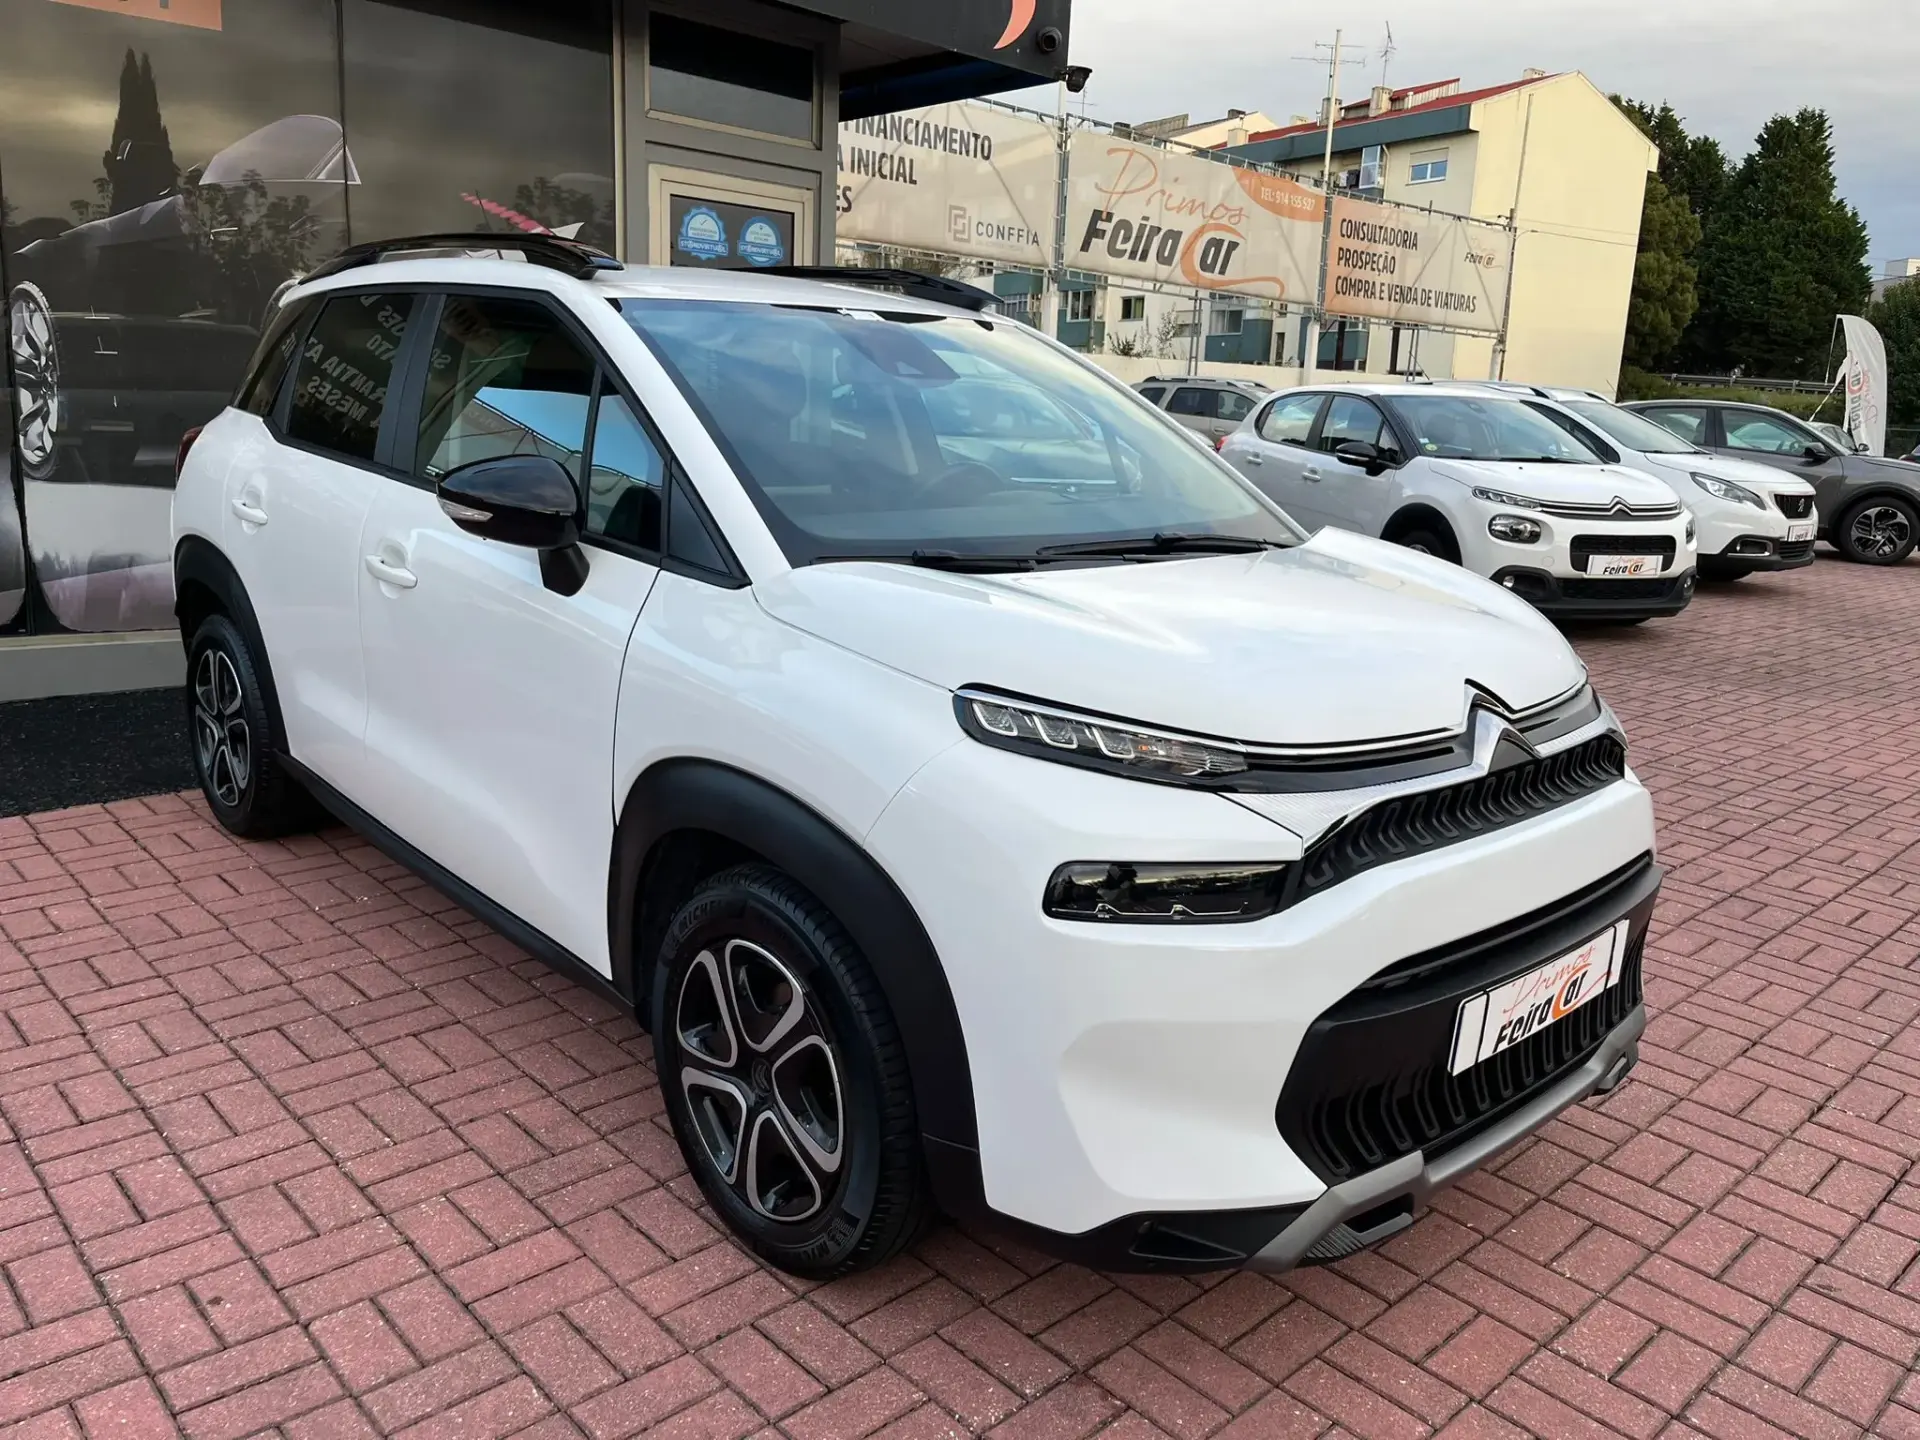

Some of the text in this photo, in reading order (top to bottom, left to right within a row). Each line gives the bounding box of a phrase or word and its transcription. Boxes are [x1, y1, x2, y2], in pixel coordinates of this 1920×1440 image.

[844, 114, 992, 161] FINANCIAMENTO
[851, 146, 917, 185] INICIAL
[1095, 147, 1249, 226] Primos
[976, 221, 1040, 246] CONFFIA
[1340, 218, 1418, 251] CONSULTADORIA
[1337, 247, 1396, 276] PROSPEÇÃO
[1335, 275, 1477, 313] COMPRA E VENDA DE VIATURAS
[1503, 944, 1596, 1027] Primos
[1492, 963, 1593, 1053] FeiraCar
